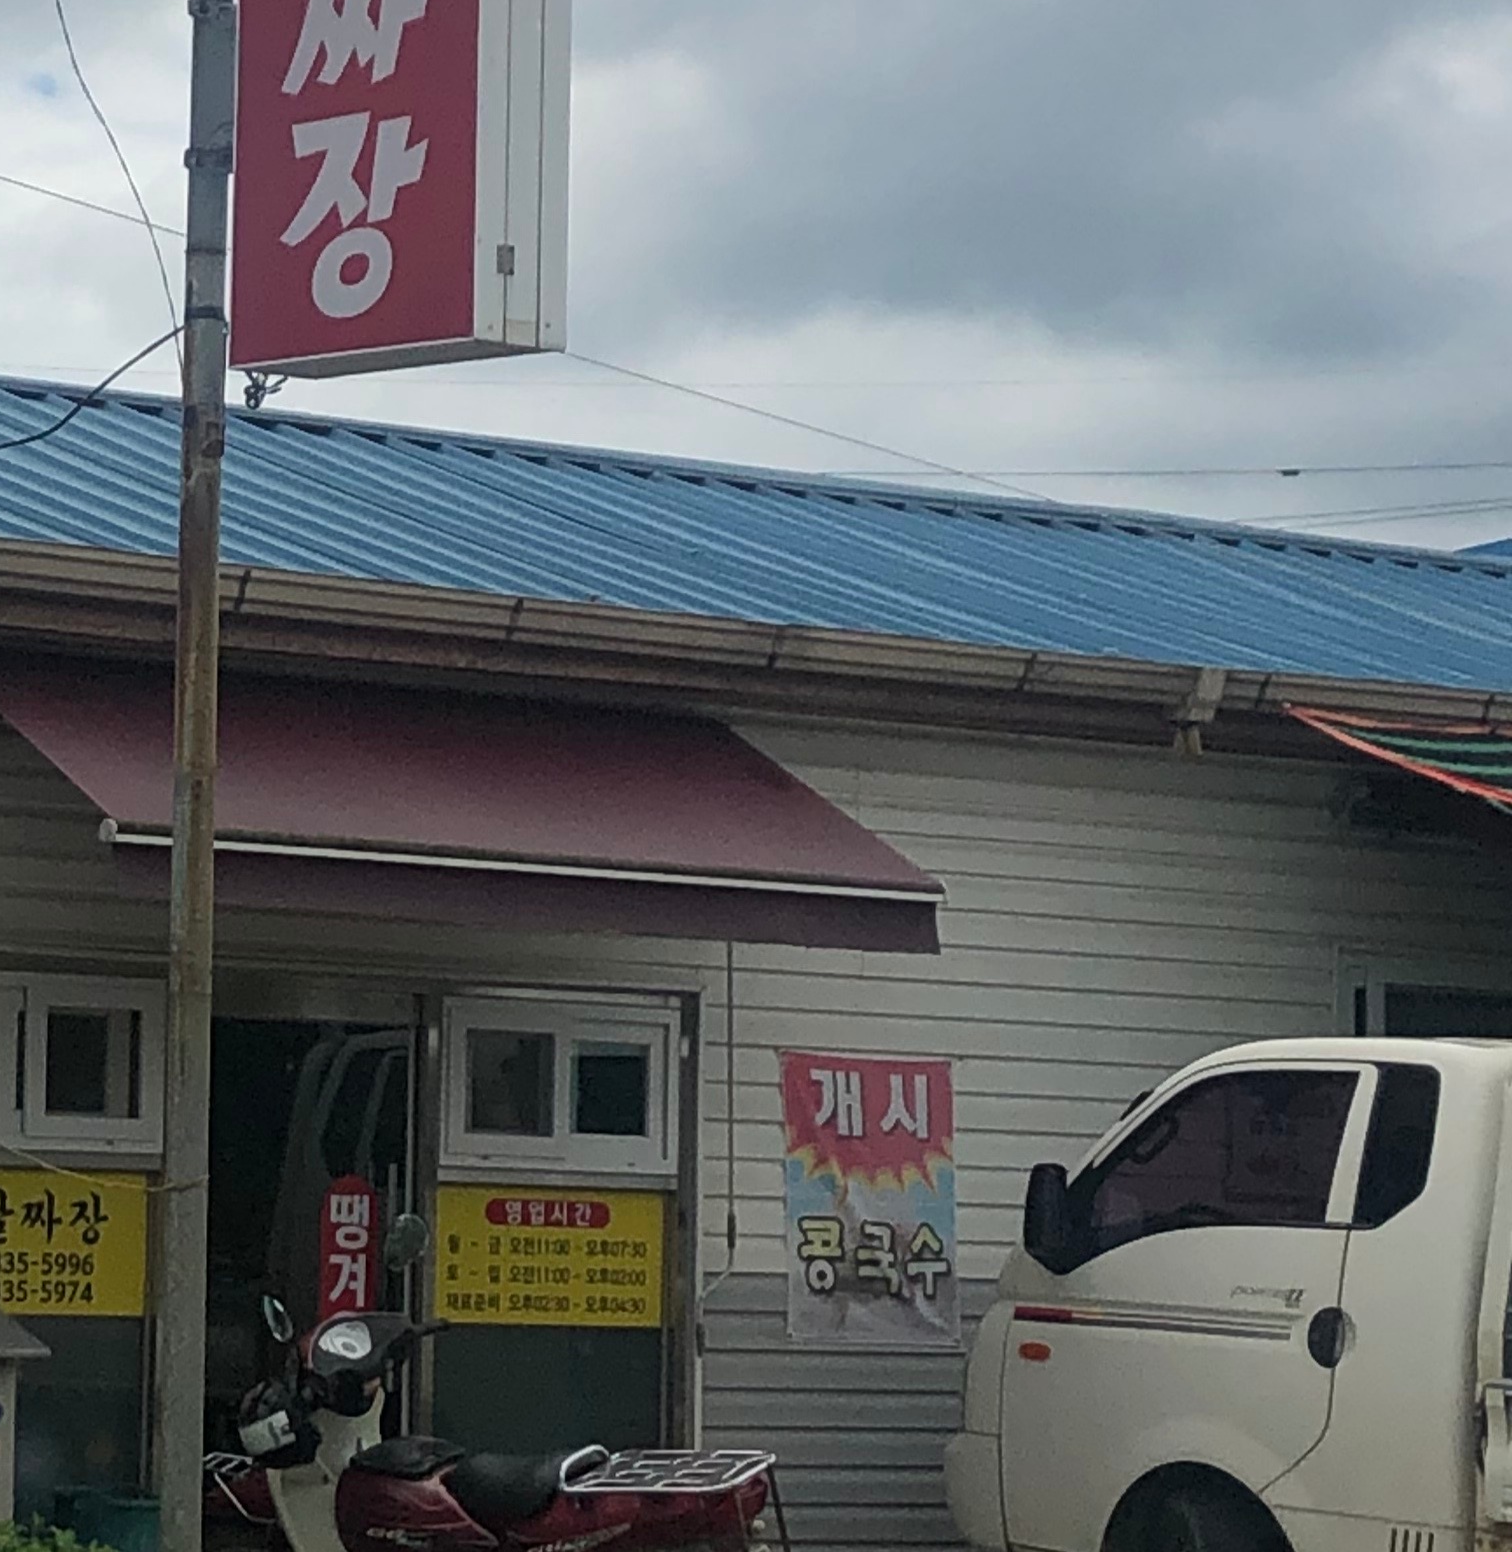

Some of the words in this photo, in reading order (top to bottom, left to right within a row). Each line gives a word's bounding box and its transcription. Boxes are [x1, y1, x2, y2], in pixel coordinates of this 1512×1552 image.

[809, 1067, 930, 1140] 개시
[328, 1193, 371, 1308] 땡겨
[505, 1200, 592, 1227] 영업시간
[797, 1216, 950, 1296] 콩국수
